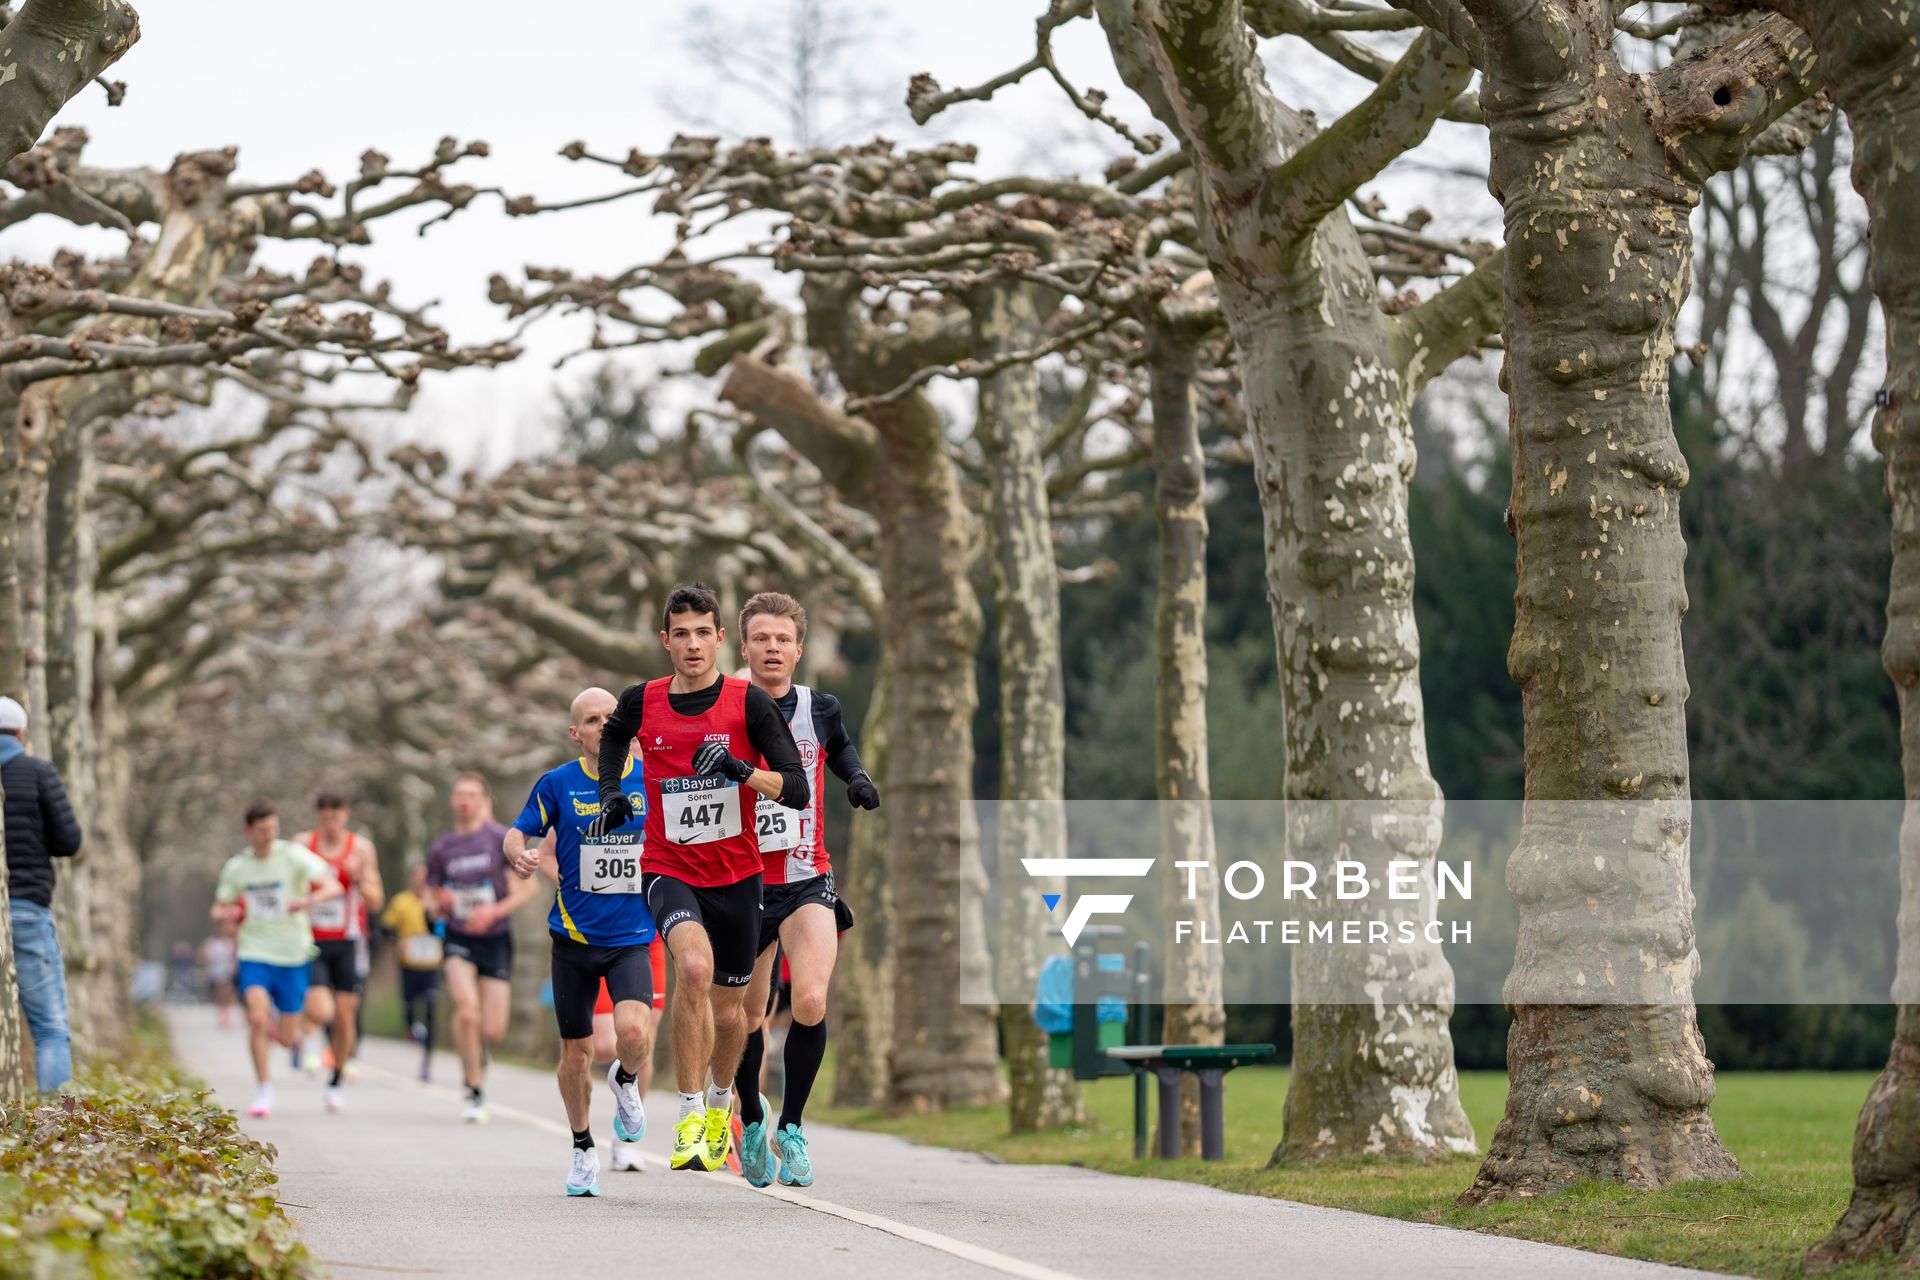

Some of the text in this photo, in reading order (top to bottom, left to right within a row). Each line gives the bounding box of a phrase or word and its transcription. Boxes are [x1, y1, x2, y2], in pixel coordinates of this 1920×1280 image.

[704, 734, 730, 742] ACTIVE
[682, 777, 718, 790] Bayer
[687, 793, 713, 802] Sören
[754, 802, 775, 812] othar
[680, 802, 724, 828] 447
[757, 812, 787, 837] 25
[601, 833, 635, 845] Bayer
[603, 847, 629, 855] Maxim
[595, 858, 636, 879] 305
[728, 974, 752, 983] FUS
